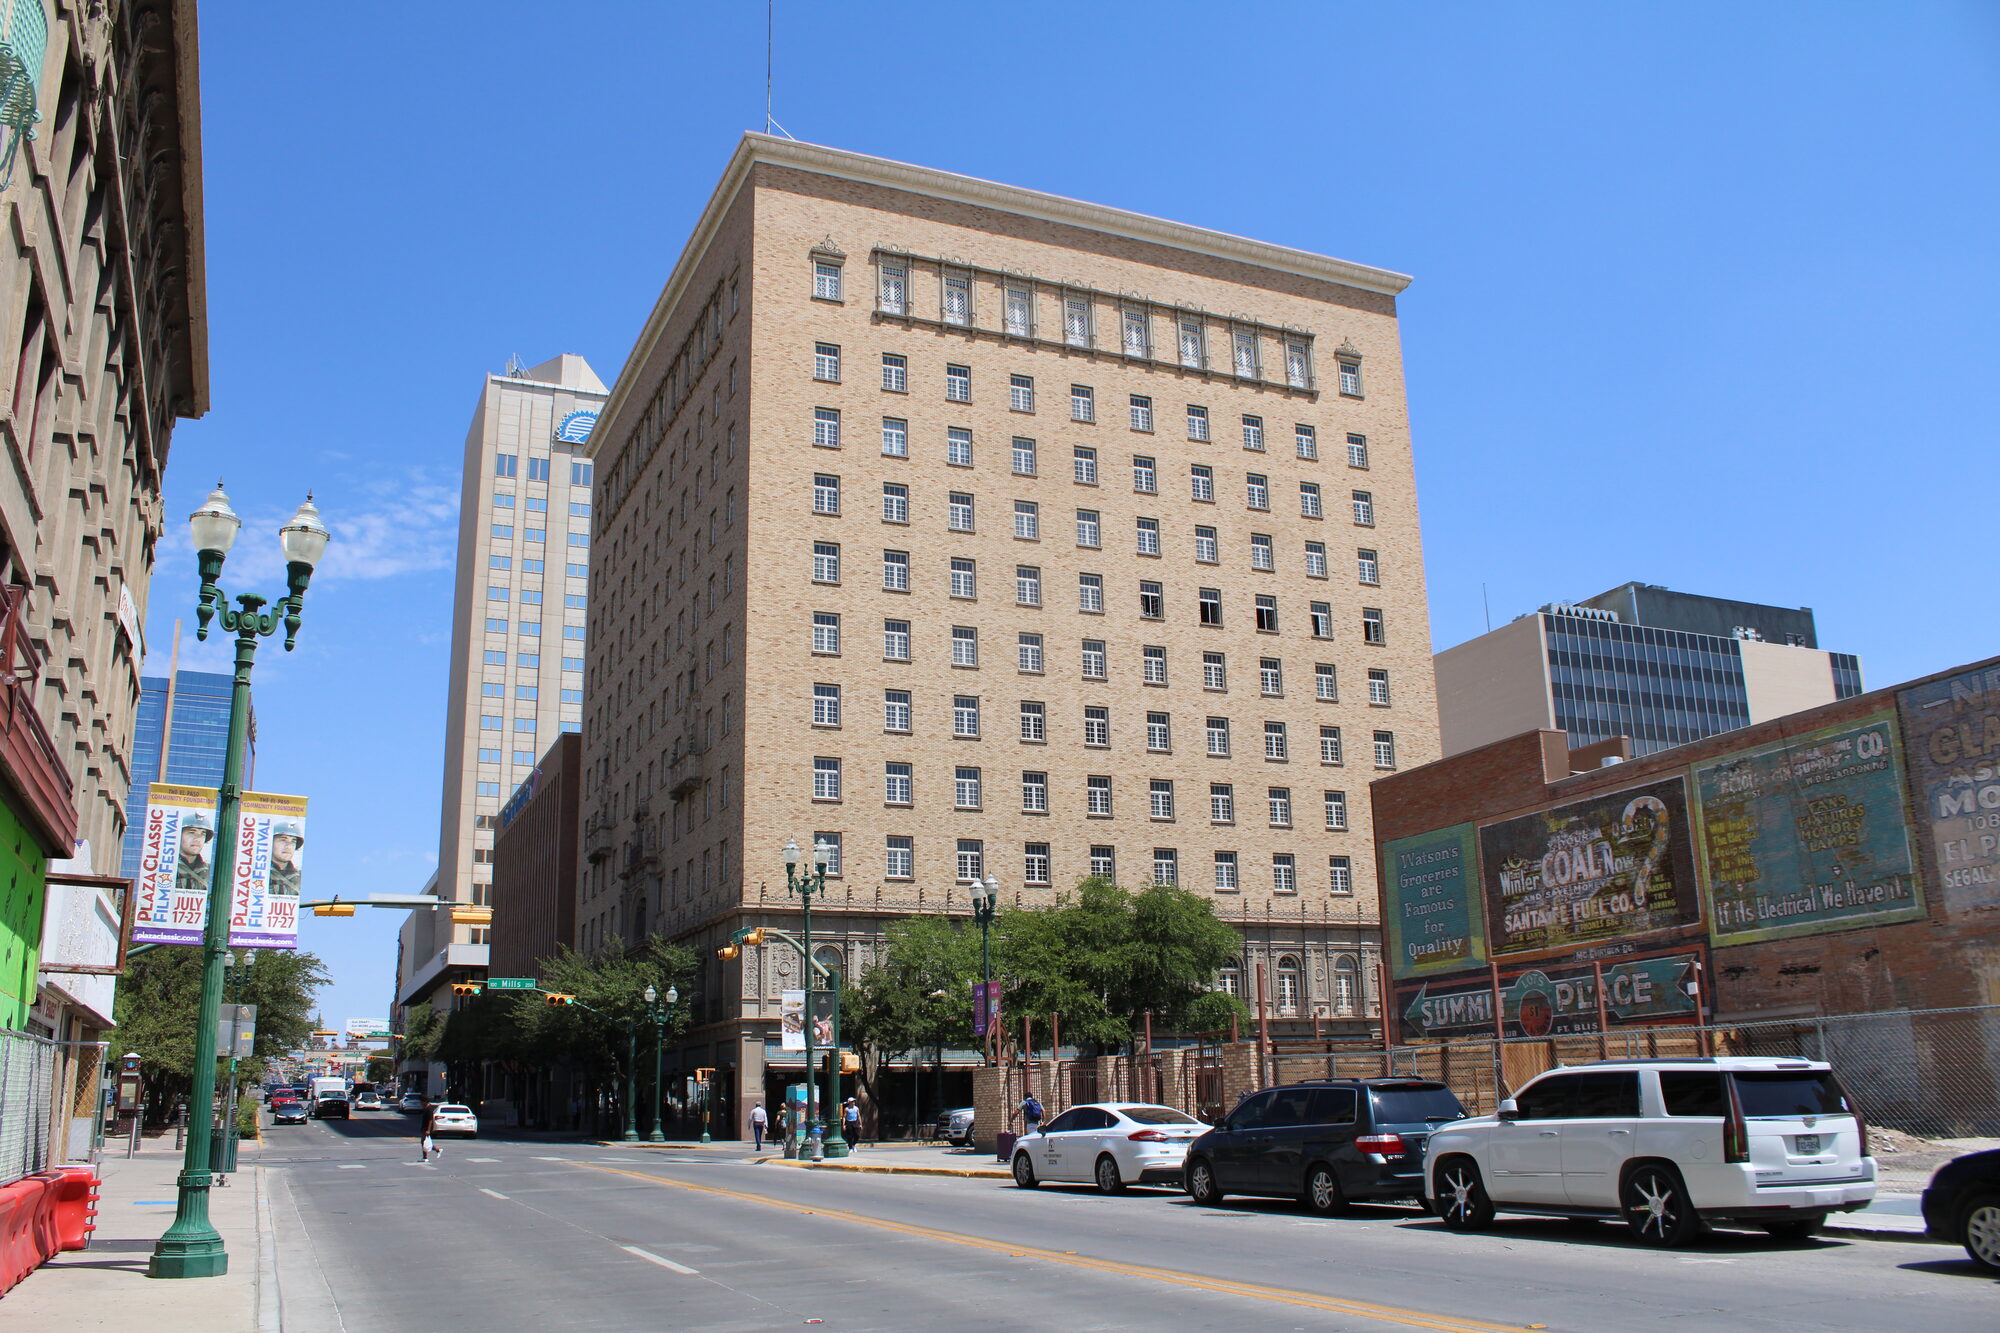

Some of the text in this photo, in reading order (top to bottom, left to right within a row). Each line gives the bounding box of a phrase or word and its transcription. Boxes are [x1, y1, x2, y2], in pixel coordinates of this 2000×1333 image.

[151, 793, 216, 805] COMMUNITY FOUNDATION
[1800, 804, 1865, 827] FIXTURES
[1801, 819, 1861, 841] MOTORS
[1809, 834, 1857, 852] LAMPS
[1944, 839, 1974, 861] EL
[153, 810, 179, 923] FILM FESTIVAL
[1400, 847, 1459, 869] Watson's
[248, 818, 271, 928] FILM FESTIVAL
[1400, 866, 1459, 888] Groceries
[1500, 869, 1540, 896] Winter
[1541, 844, 1599, 888] COAL
[1421, 884, 1442, 898] are
[1756, 887, 1817, 920] Electrical
[1819, 883, 1843, 909] We
[1845, 881, 1884, 906] Have
[174, 896, 204, 912] JULY
[268, 902, 296, 917] JULY
[1404, 898, 1455, 918] Famous
[172, 911, 202, 924] 17-27
[267, 916, 295, 929] 17-27
[1504, 909, 1549, 933] SANTA
[1573, 896, 1607, 920] FUEL
[1424, 918, 1445, 934] for
[136, 931, 199, 943] plazaclassic.com
[232, 936, 293, 946] plazaclassic.com
[1408, 936, 1463, 960] Quality
[501, 980, 521, 988] Mills
[1573, 1022, 1599, 1032] BLIS
